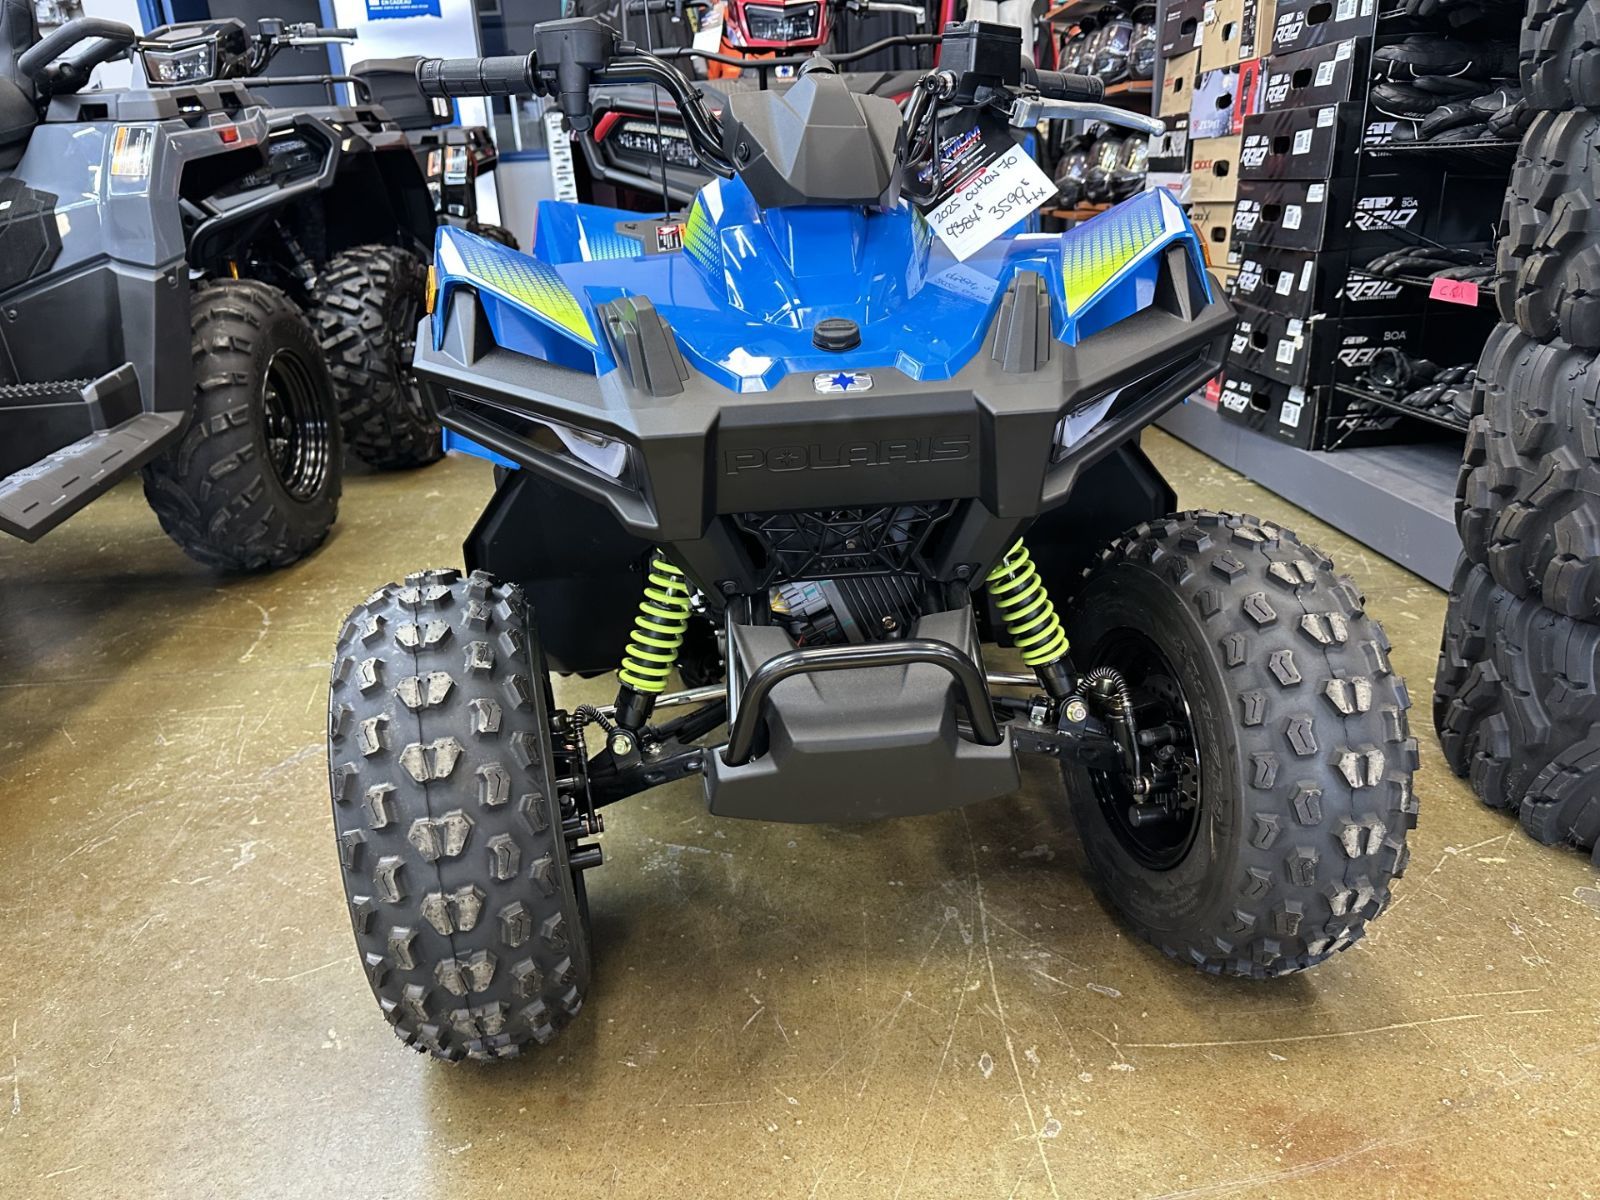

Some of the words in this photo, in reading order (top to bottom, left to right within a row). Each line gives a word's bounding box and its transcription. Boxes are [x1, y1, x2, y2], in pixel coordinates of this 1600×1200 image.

[1273, 21, 1303, 43] RAID
[1266, 84, 1290, 103] RAID
[1240, 147, 1268, 166] RAID
[934, 198, 961, 224] 2025
[997, 156, 1018, 169] 70
[1347, 209, 1418, 231] RAID
[1384, 331, 1407, 341] BOA
[1337, 347, 1383, 367] RAI
[1220, 389, 1250, 413] RAID
[724, 435, 970, 475] POLARIS
